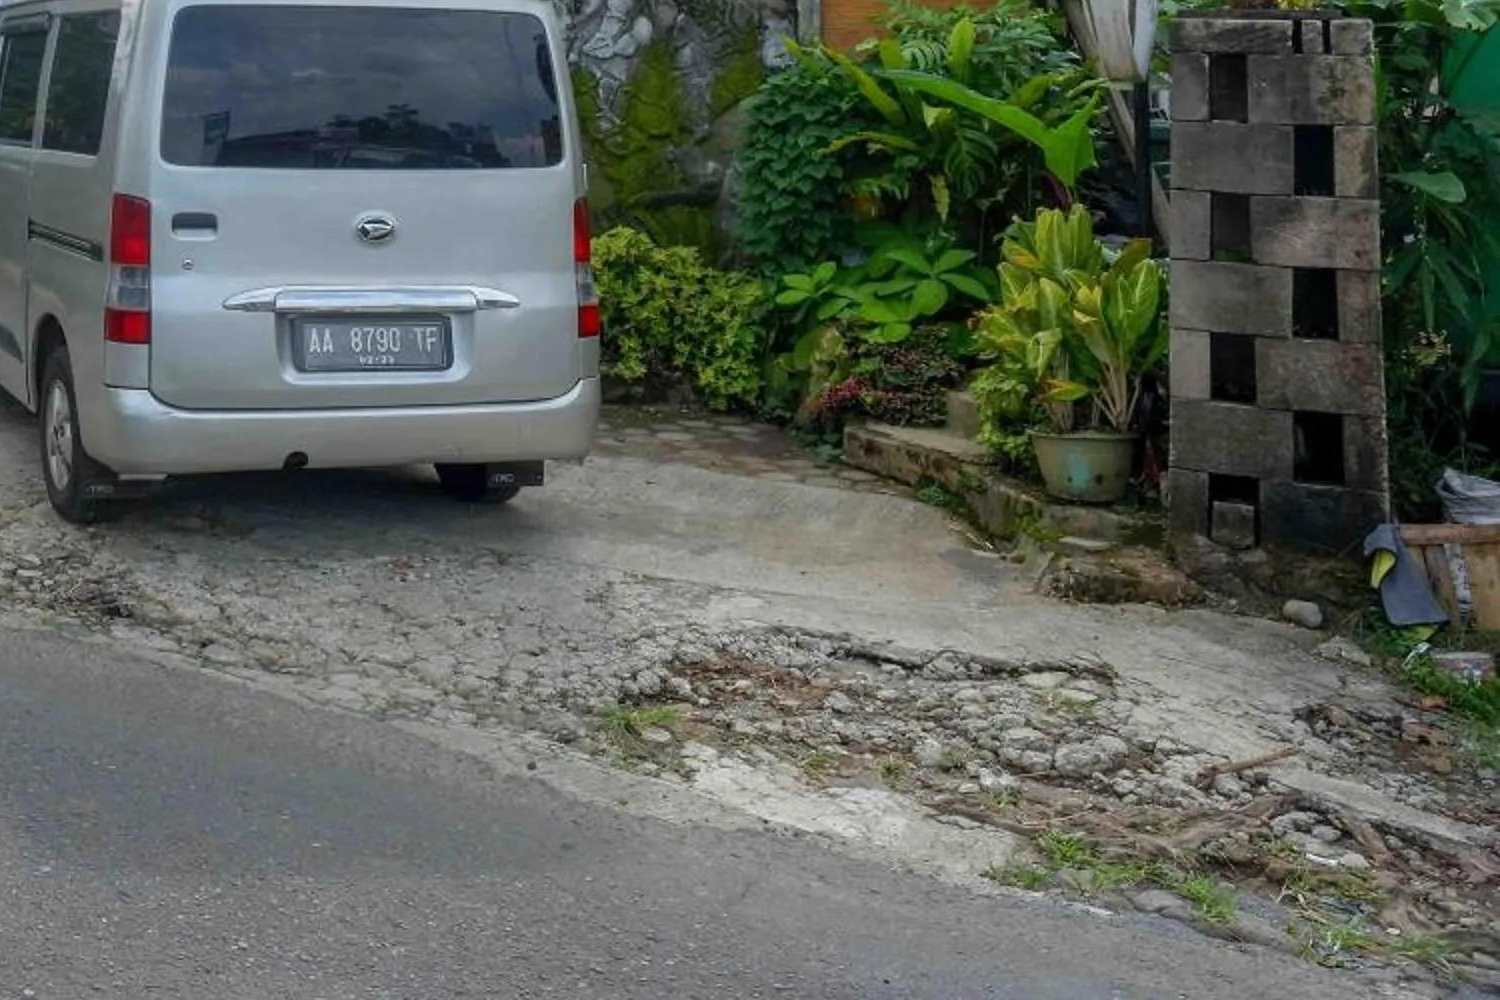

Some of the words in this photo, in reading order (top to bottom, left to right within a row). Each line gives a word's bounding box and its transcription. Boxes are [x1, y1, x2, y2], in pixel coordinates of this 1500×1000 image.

[309, 327, 334, 353] AA
[350, 327, 401, 353] 8790
[412, 326, 437, 353] TF
